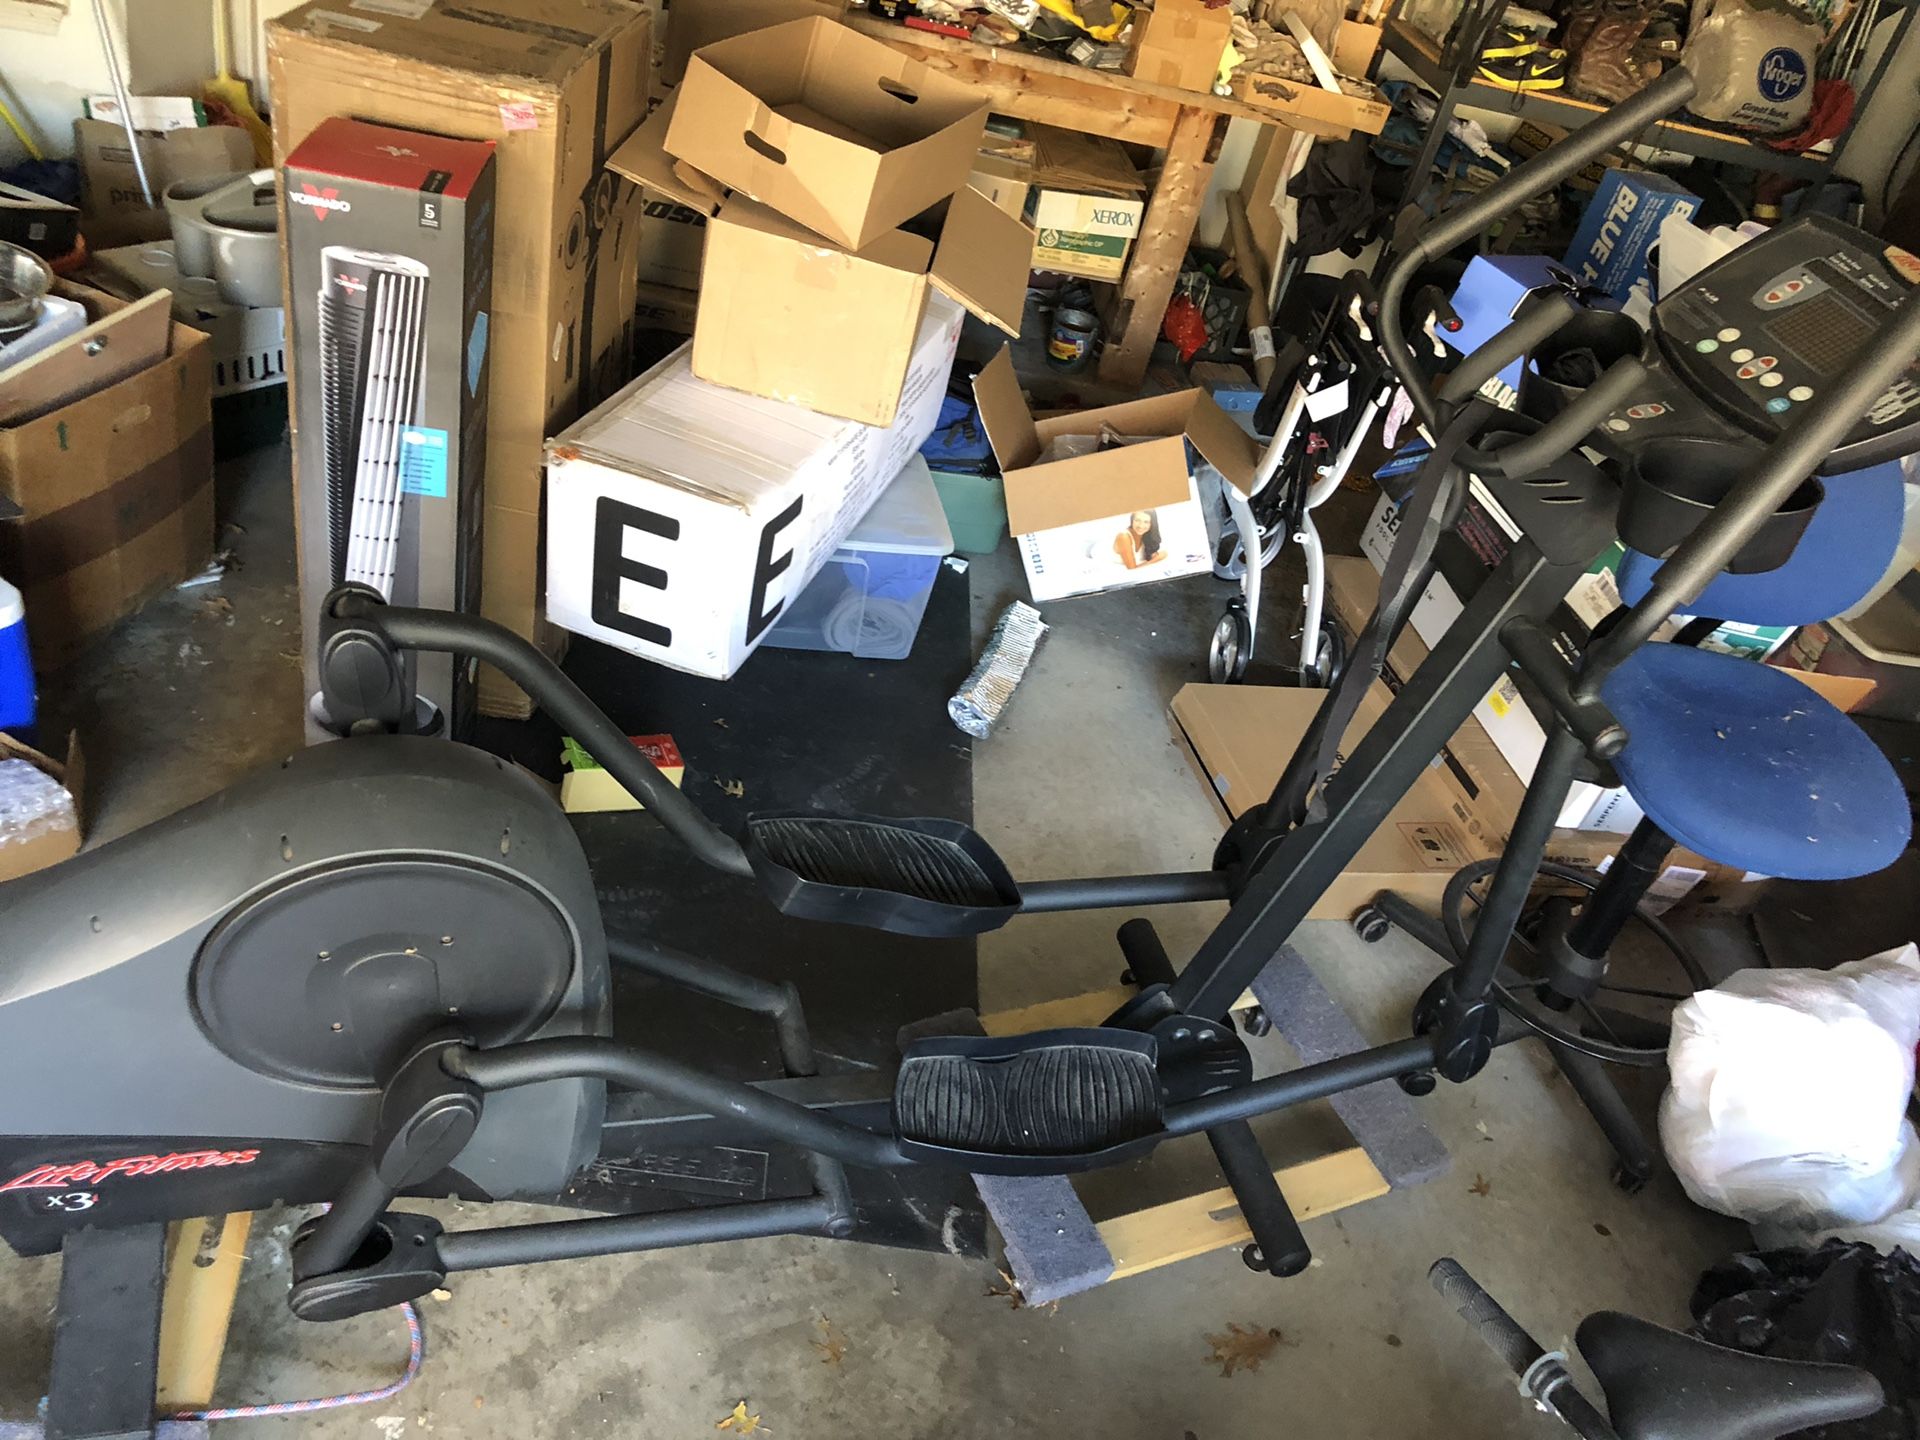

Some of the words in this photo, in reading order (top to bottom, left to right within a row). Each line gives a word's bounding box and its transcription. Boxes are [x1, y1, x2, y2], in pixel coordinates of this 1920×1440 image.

[1763, 54, 1804, 95] Kroger
[1091, 208, 1135, 227] XEROX
[1590, 185, 1639, 266] BLUE
[591, 495, 681, 648] E
[745, 494, 804, 647] E
[1593, 791, 1623, 828] SERPENT
